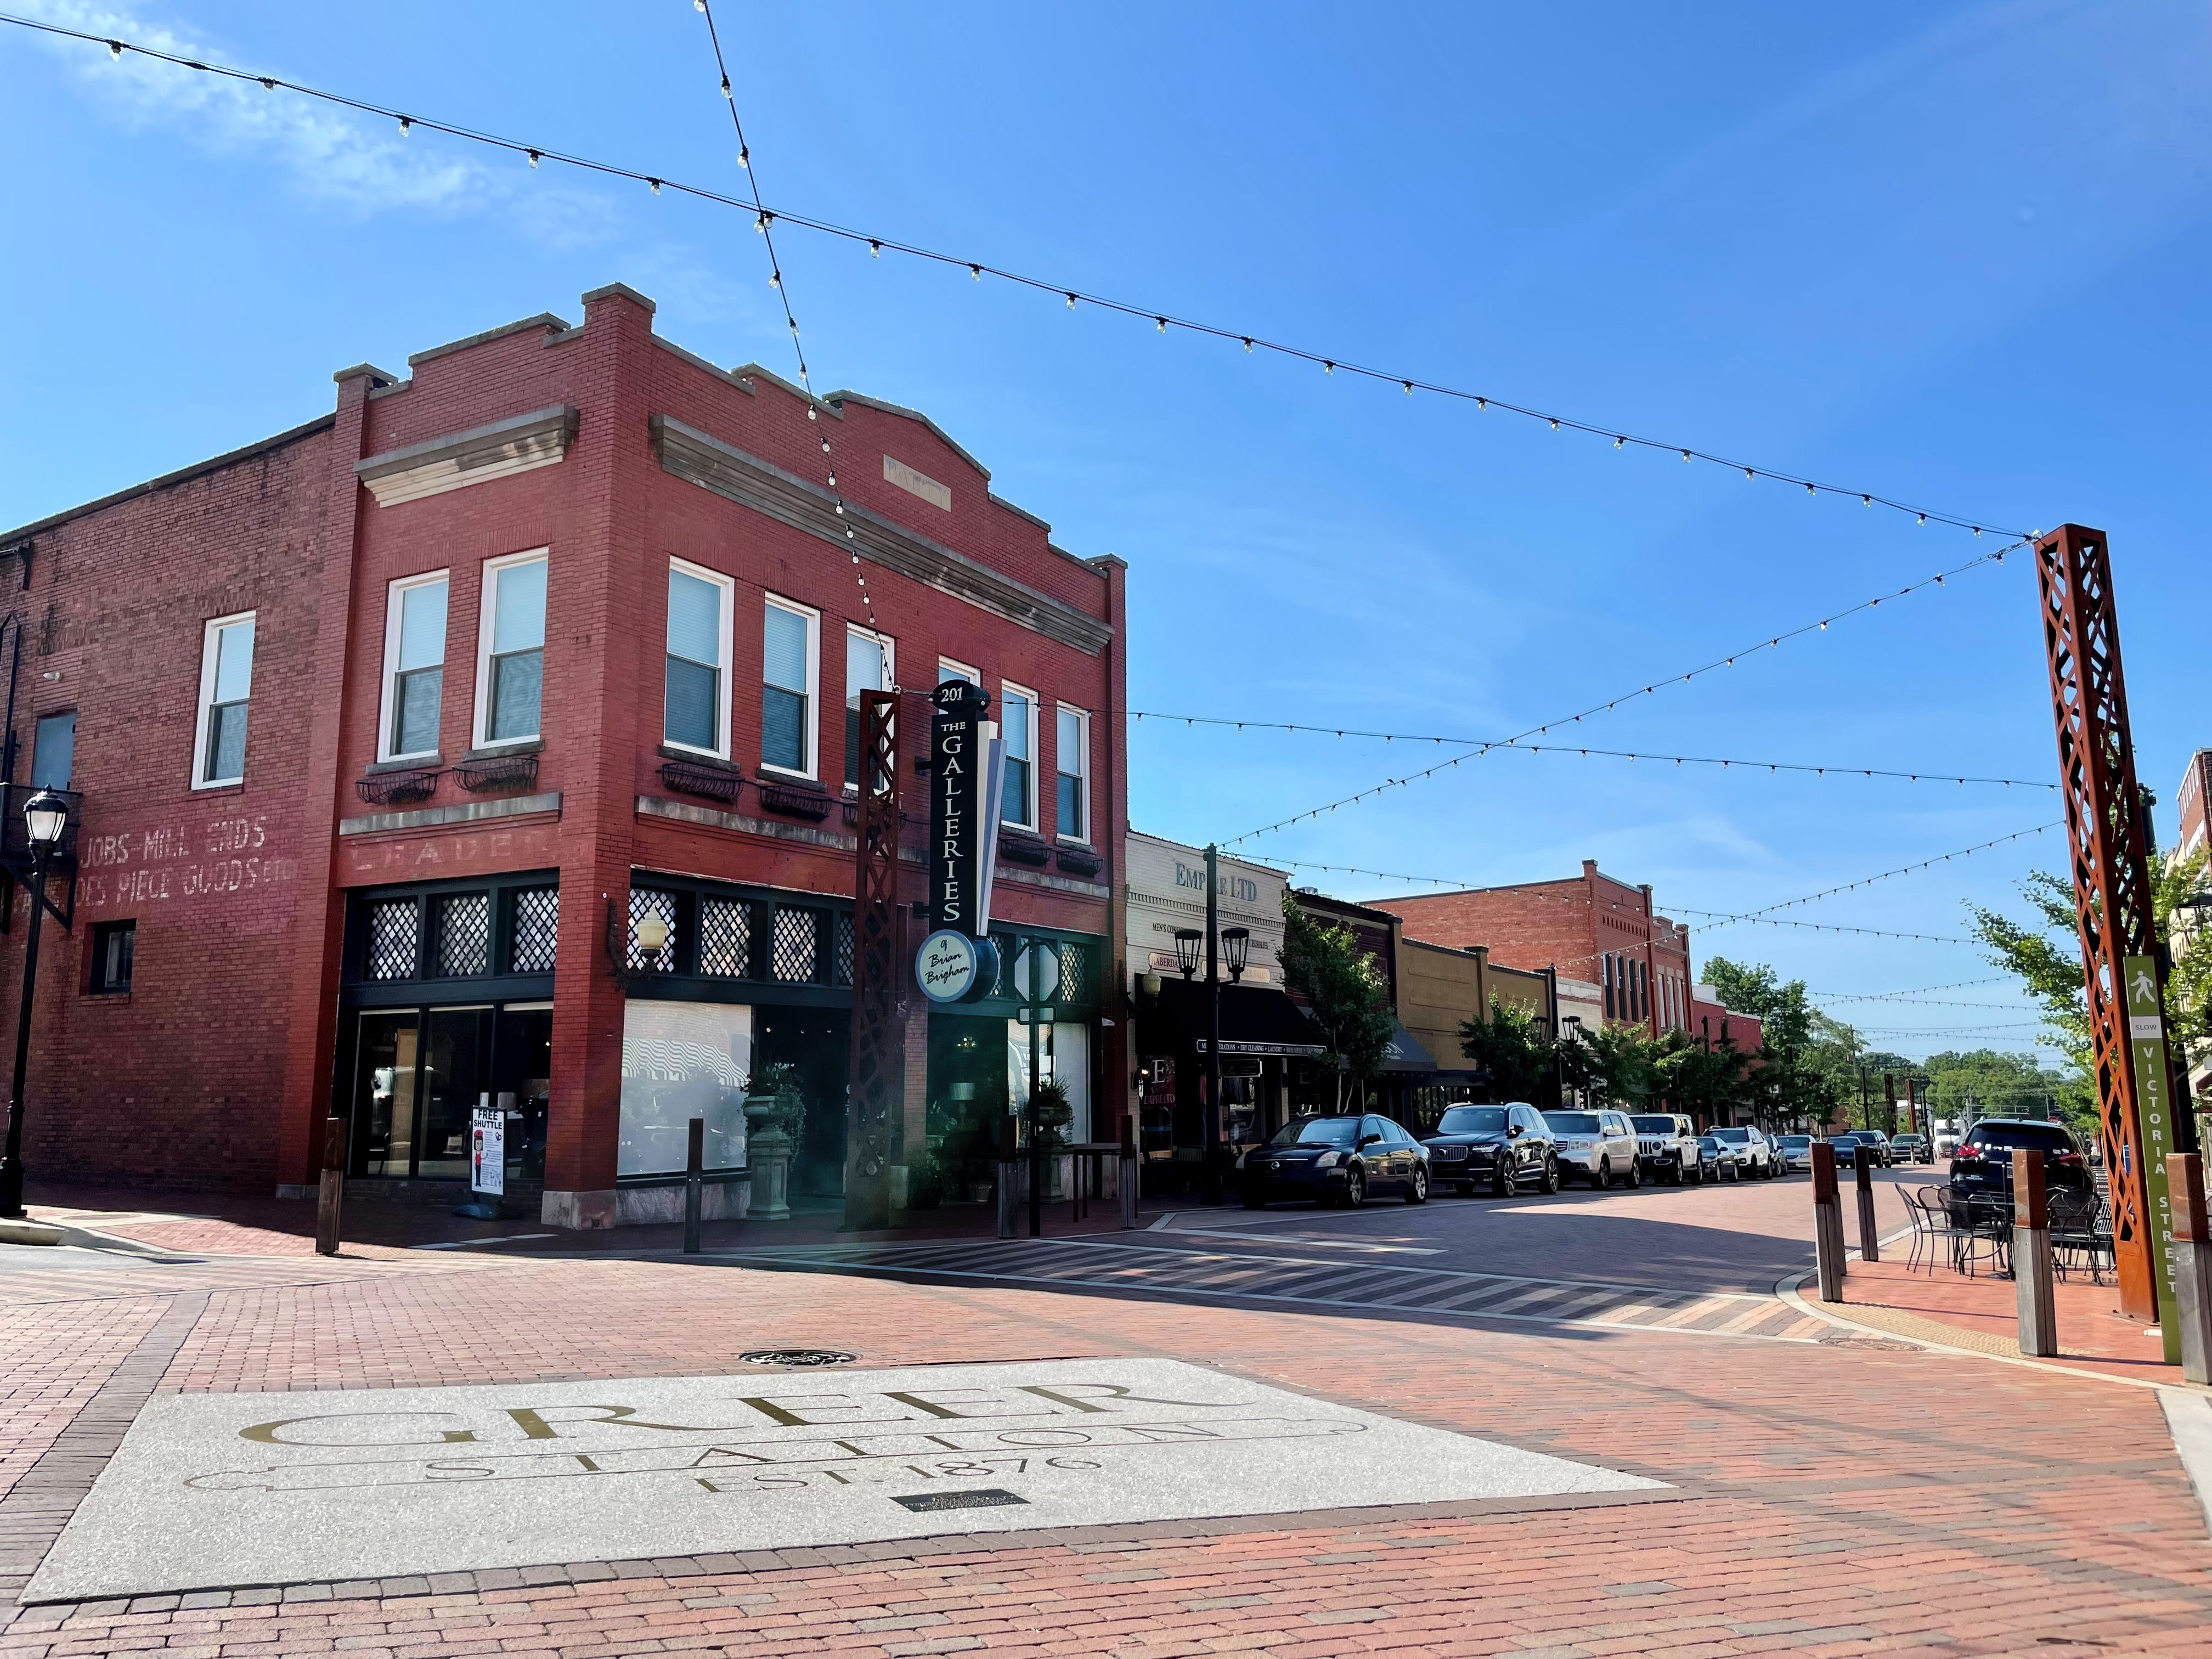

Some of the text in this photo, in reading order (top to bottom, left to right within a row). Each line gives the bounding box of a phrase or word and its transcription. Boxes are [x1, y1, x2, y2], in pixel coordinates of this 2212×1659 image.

[941, 687, 963, 702] 201
[941, 721, 966, 732] THE
[942, 736, 963, 921] GALLERIES
[116, 867, 173, 904] PIECE
[1176, 862, 1257, 901] EMPE LTD
[925, 964, 970, 984] Brigham
[928, 953, 962, 968] Brian
[473, 1119, 503, 1130] SHUTTLE
[478, 1109, 498, 1120] FREE
[2142, 1047, 2176, 1293] VICTORIA STREET
[238, 1384, 1256, 1447] GREER
[425, 1424, 1224, 1480] STATION
